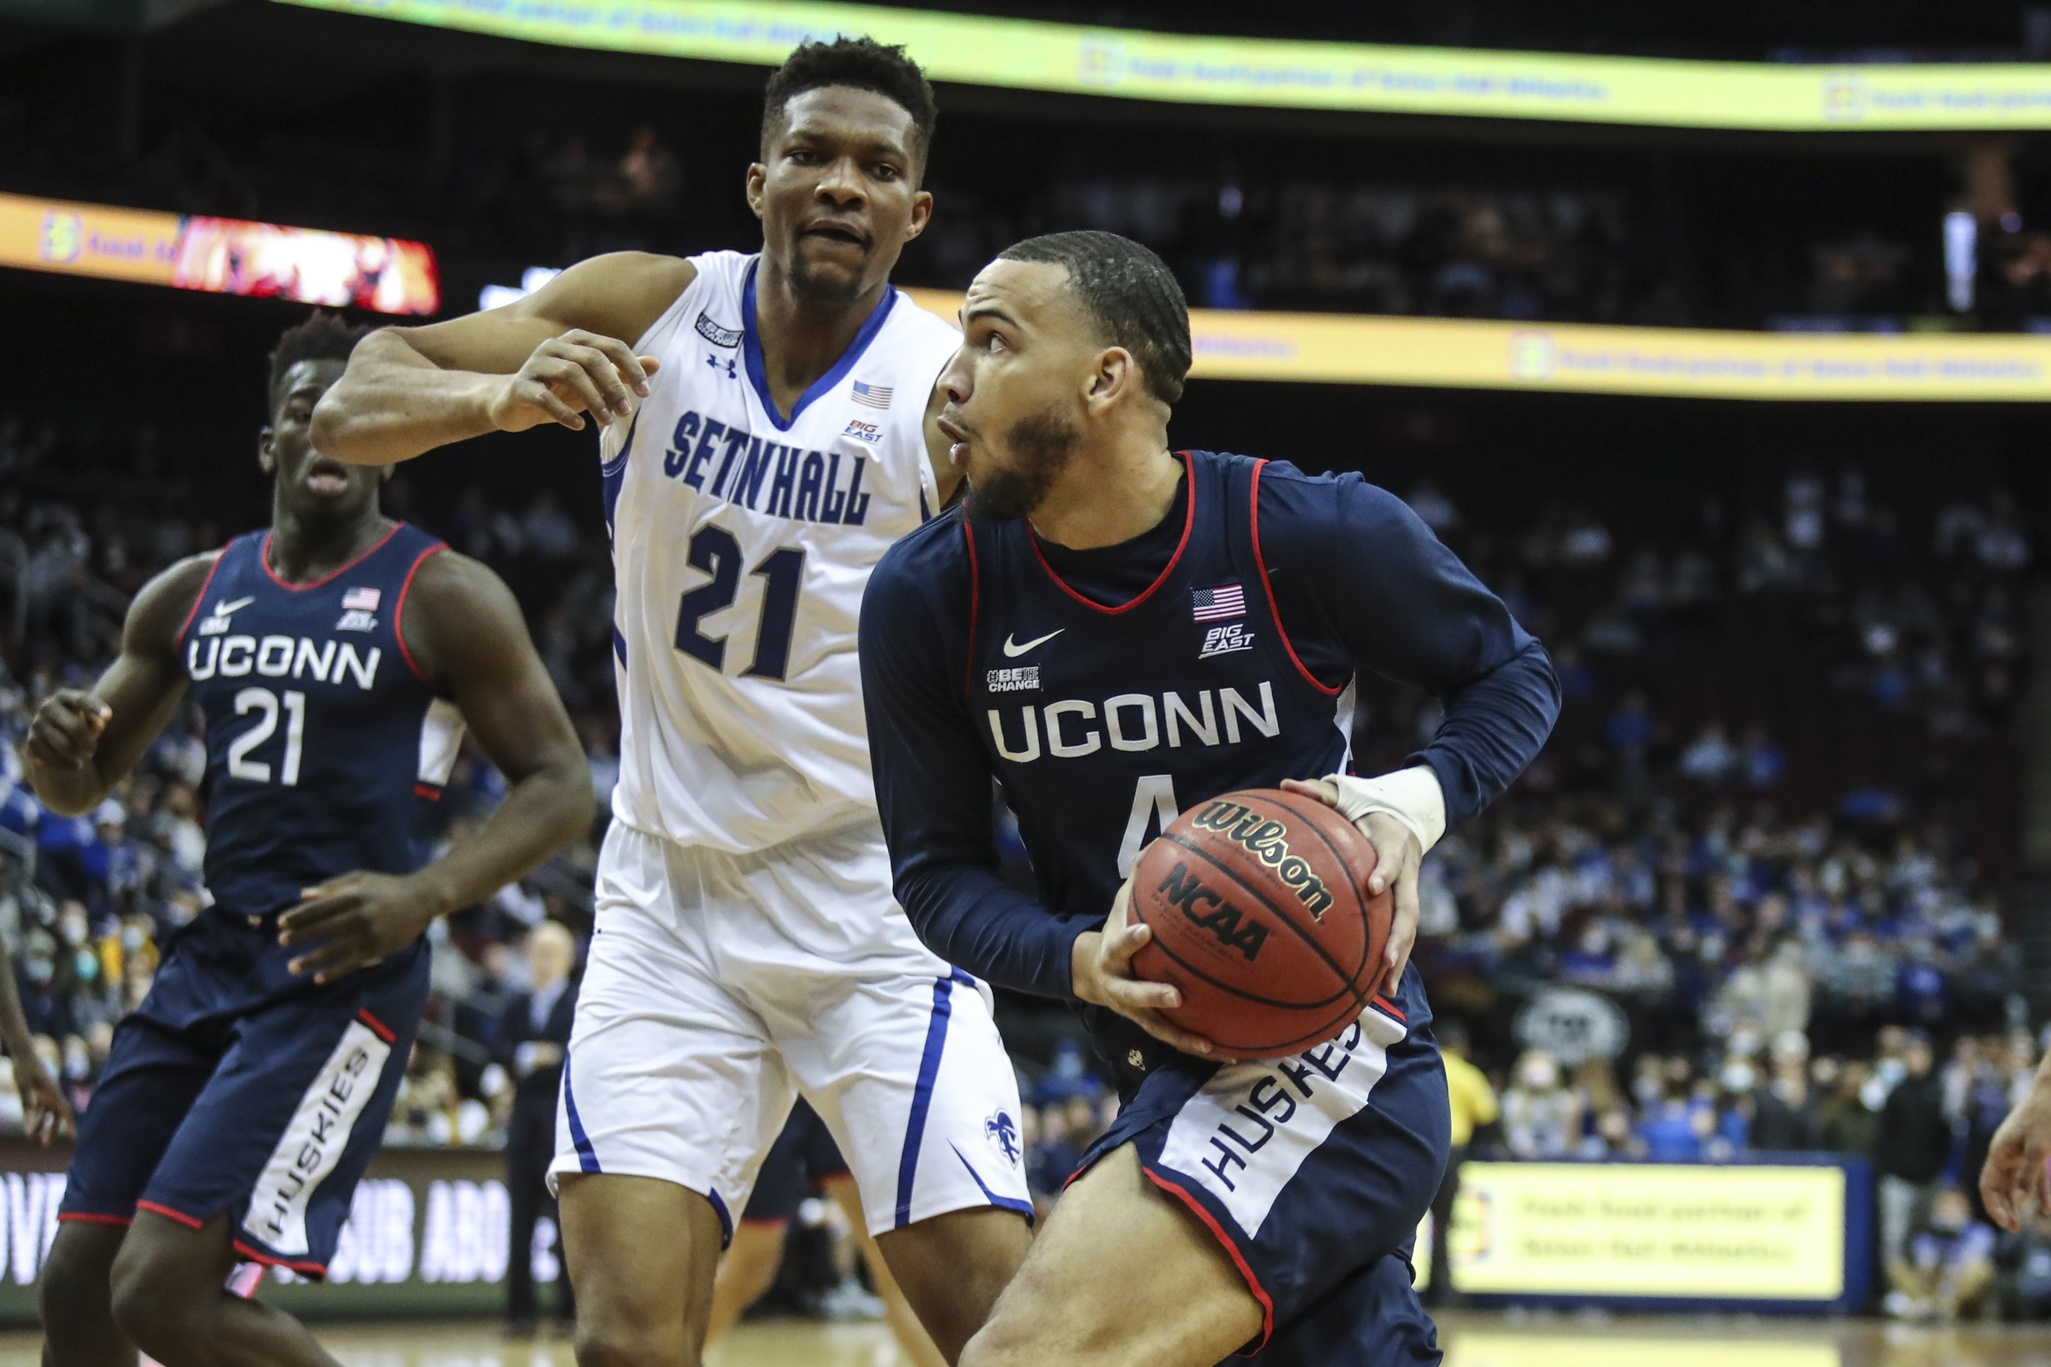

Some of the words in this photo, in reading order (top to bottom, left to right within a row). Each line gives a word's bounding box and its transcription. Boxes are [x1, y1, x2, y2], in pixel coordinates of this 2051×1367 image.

[845, 426, 883, 443] EAST
[849, 419, 878, 433] BIG
[674, 522, 806, 682] 21
[1206, 624, 1243, 641] BIG
[187, 634, 382, 690] UCONN
[1201, 633, 1255, 653] EAST
[988, 680, 1040, 692] CHANGE
[227, 686, 306, 786] 21
[987, 681, 1281, 763] UCONN
[1191, 799, 1335, 923] Wilson
[1157, 862, 1271, 962] NCAA
[266, 1047, 369, 1236] HUSKIES
